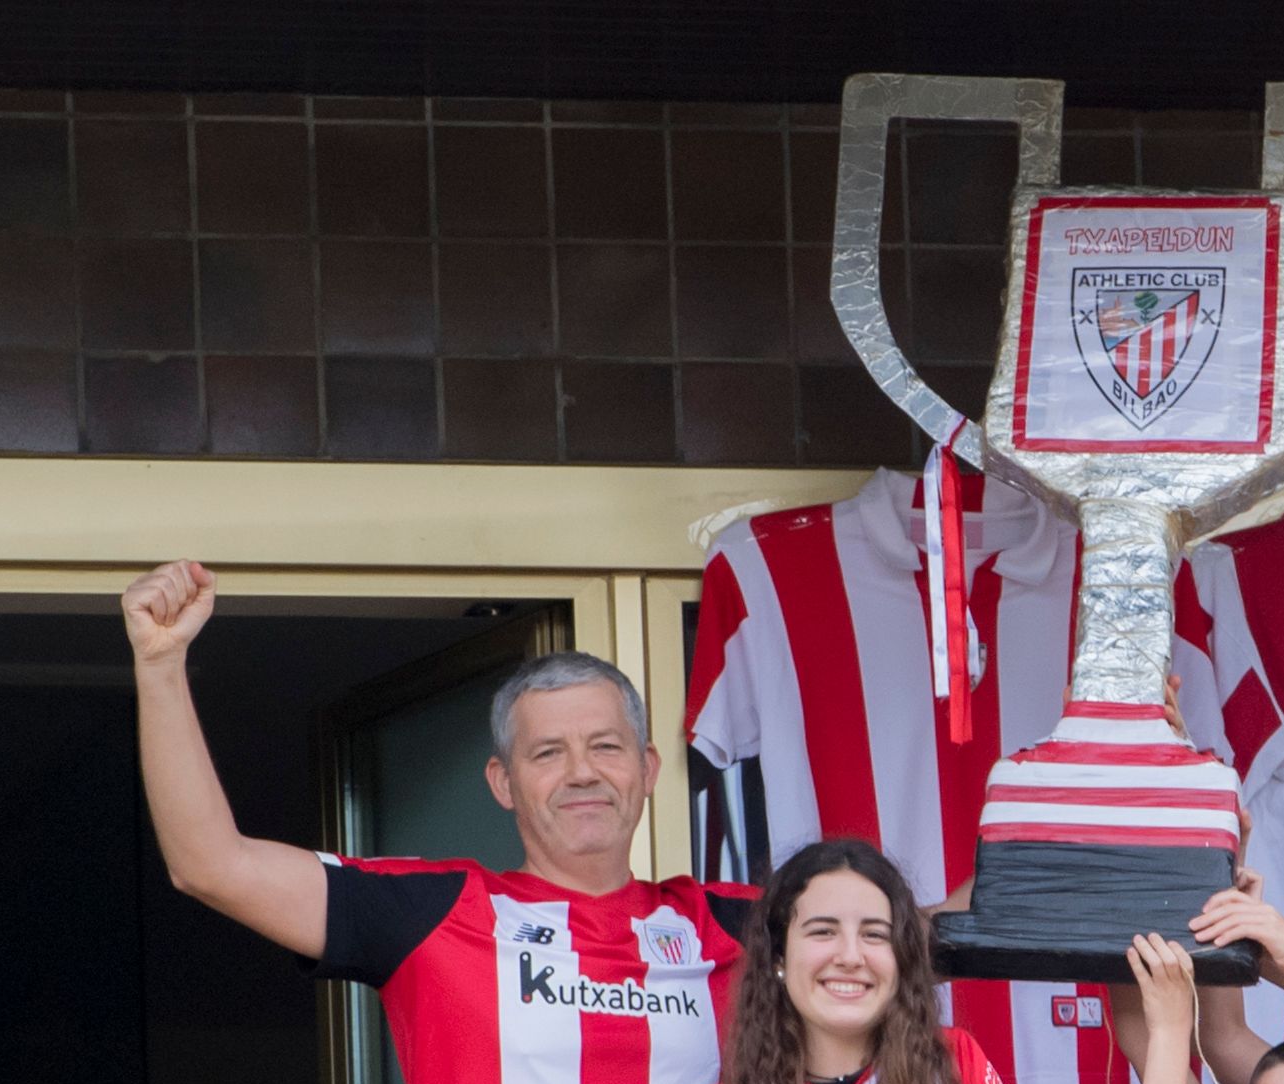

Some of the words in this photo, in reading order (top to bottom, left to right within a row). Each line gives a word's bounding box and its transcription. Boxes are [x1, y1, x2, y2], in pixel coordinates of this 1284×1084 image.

[1065, 226, 1234, 255] TXAPELDUN
[1078, 273, 1165, 287] ATHLETIC
[1170, 273, 1220, 287] CLUB
[1112, 379, 1177, 421] BILBAO
[519, 951, 700, 1018] Kutxabank
